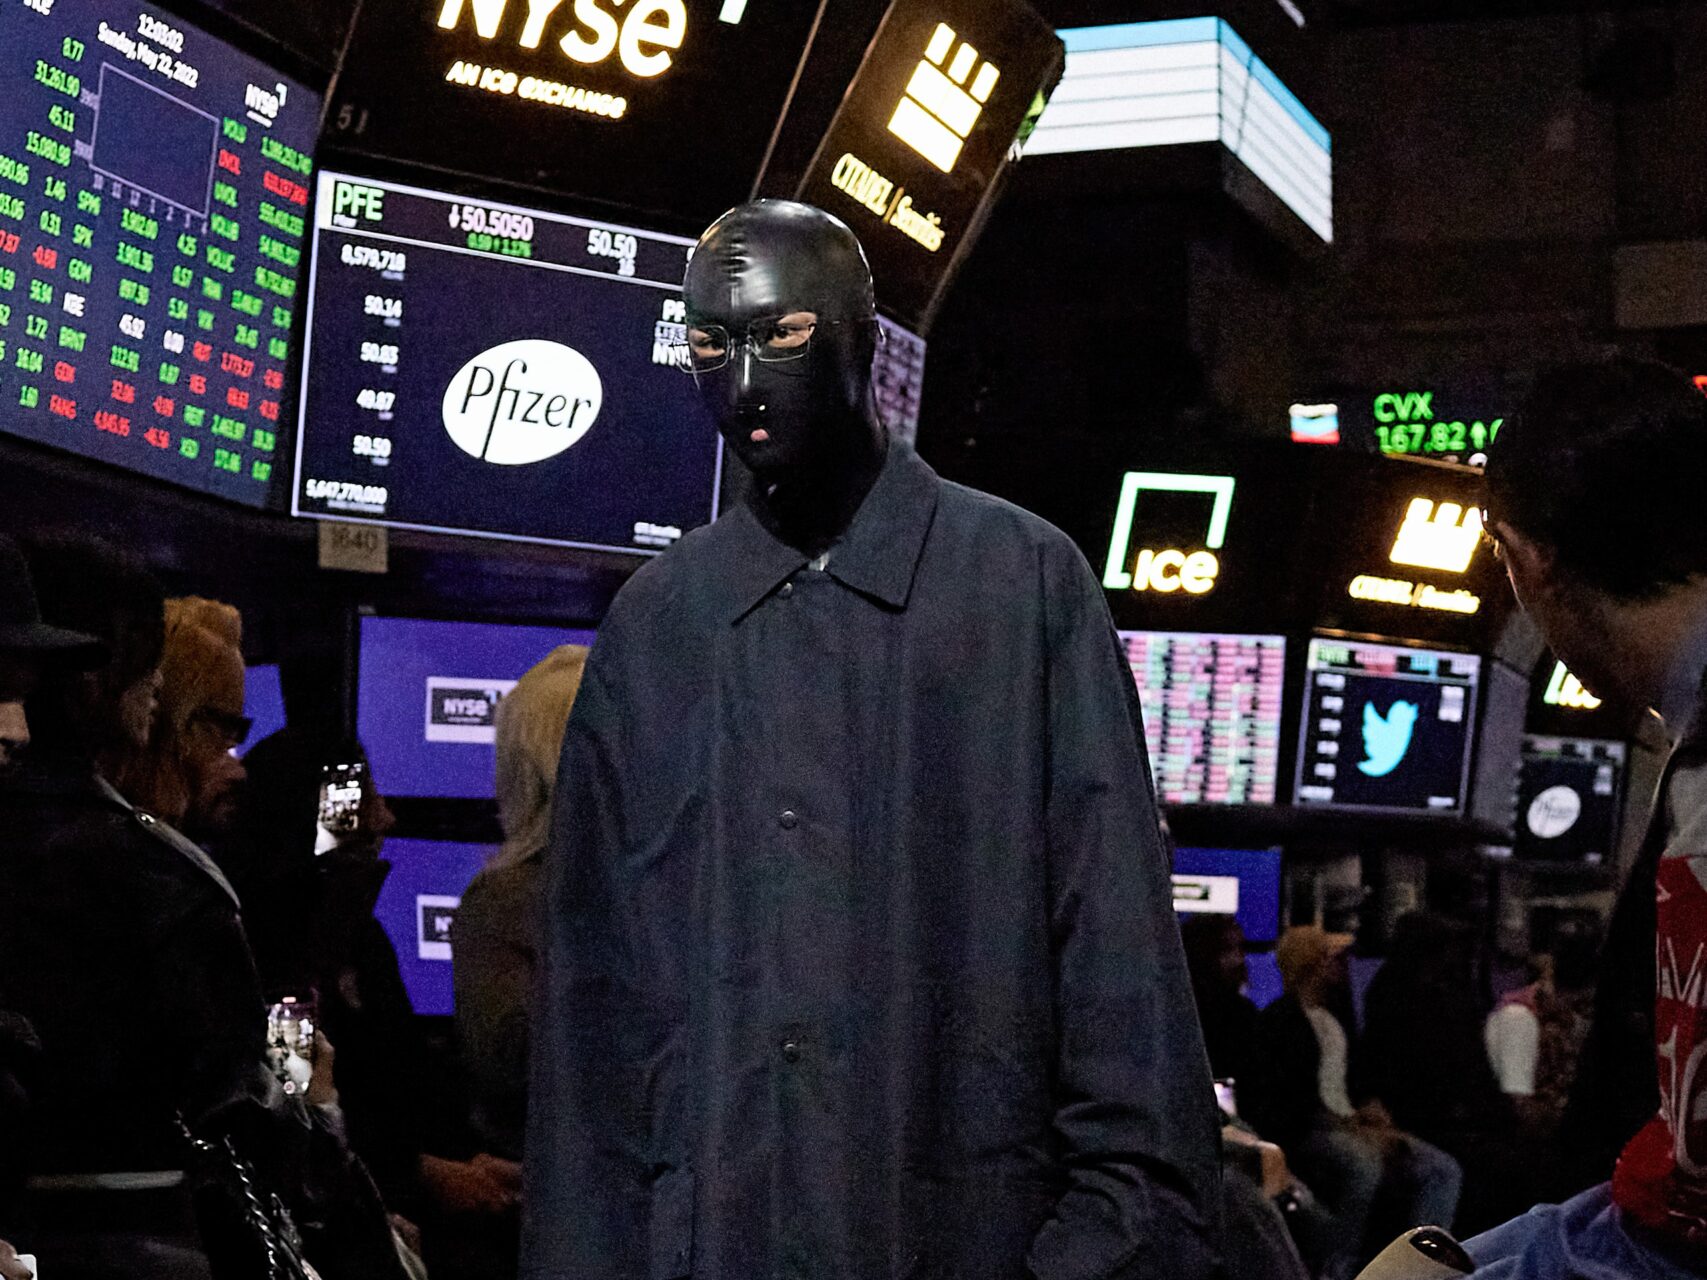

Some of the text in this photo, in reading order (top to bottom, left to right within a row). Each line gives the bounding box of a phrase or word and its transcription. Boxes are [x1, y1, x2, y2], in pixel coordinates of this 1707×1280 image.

[446, 61, 481, 86] AN
[335, 182, 385, 221] PFE
[461, 205, 534, 242] 50.5050
[587, 229, 638, 259] 50.50
[461, 358, 592, 460] Pfizer
[1374, 391, 1433, 423] CVX
[1375, 421, 1467, 454] 167.82
